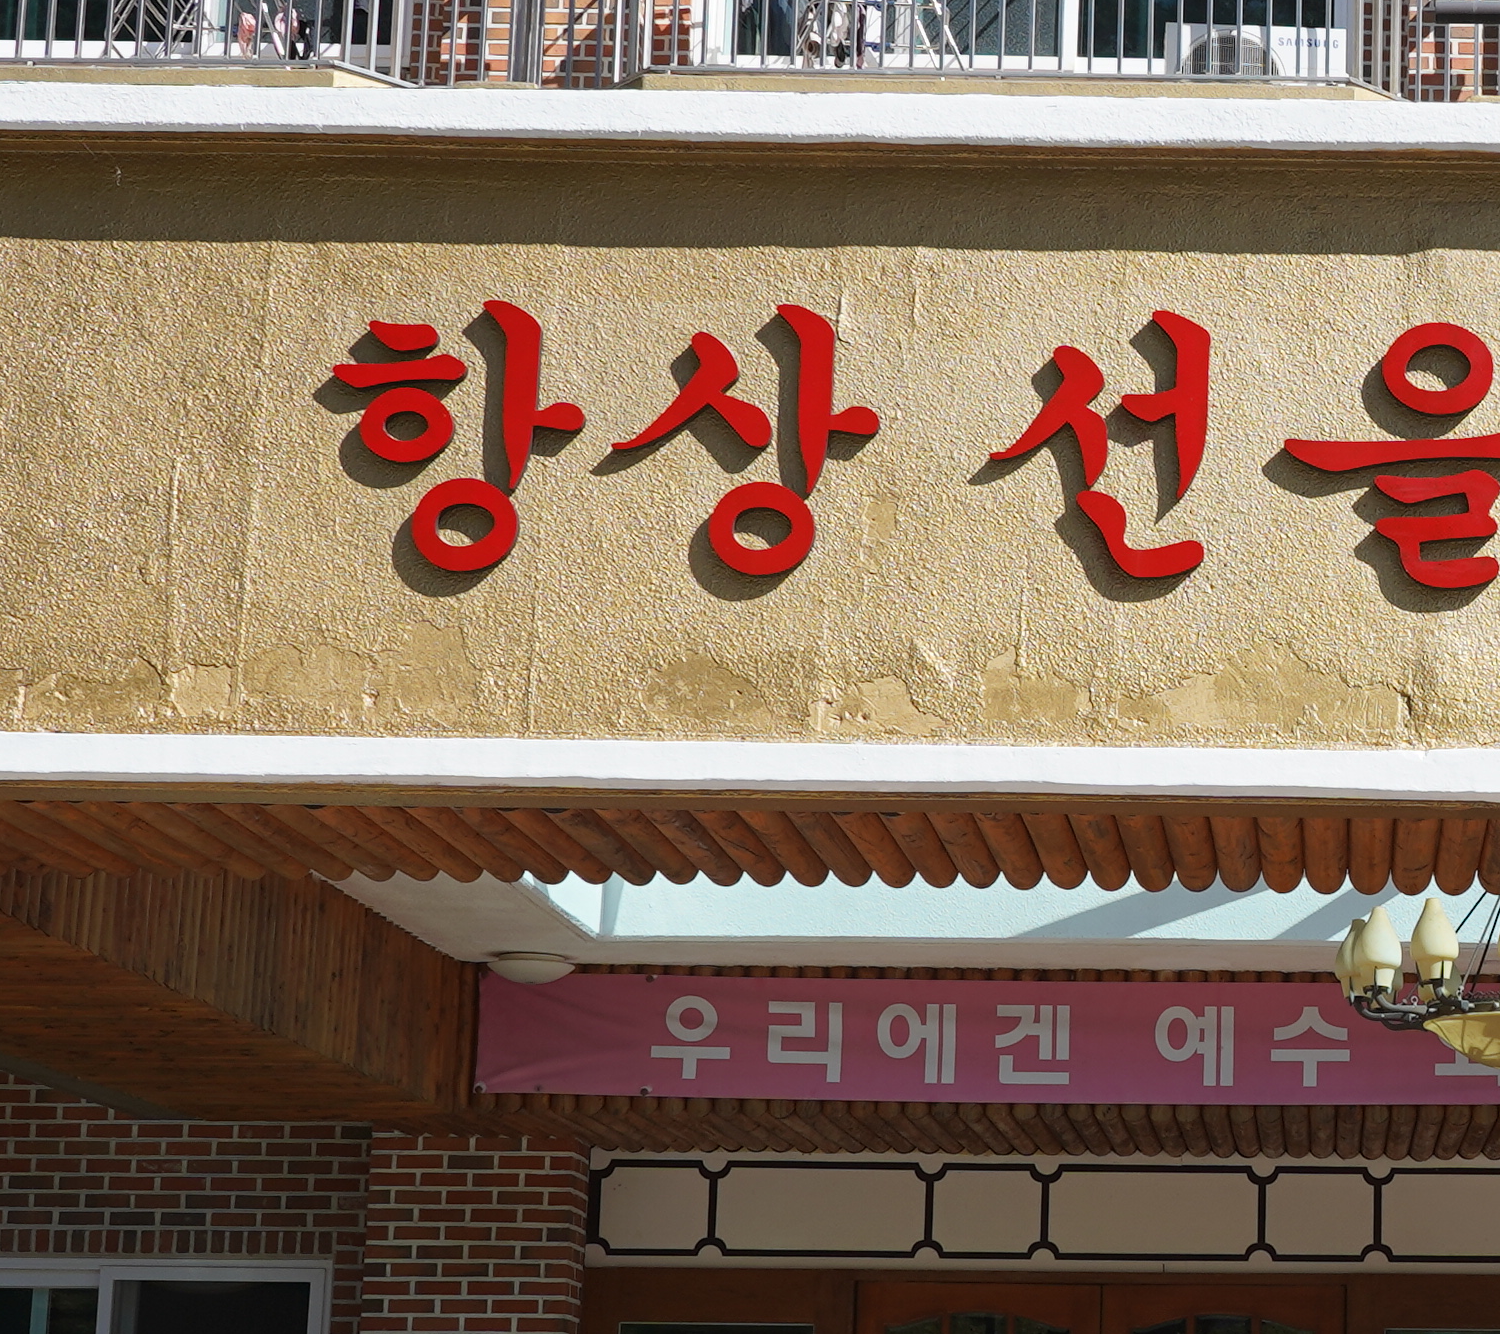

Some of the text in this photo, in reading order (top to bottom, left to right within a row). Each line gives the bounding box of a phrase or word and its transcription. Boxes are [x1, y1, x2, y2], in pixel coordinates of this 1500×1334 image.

[333, 300, 879, 576] 항상
[650, 995, 1071, 1085] 우리에겐
[1155, 1006, 1350, 1087] 예수
